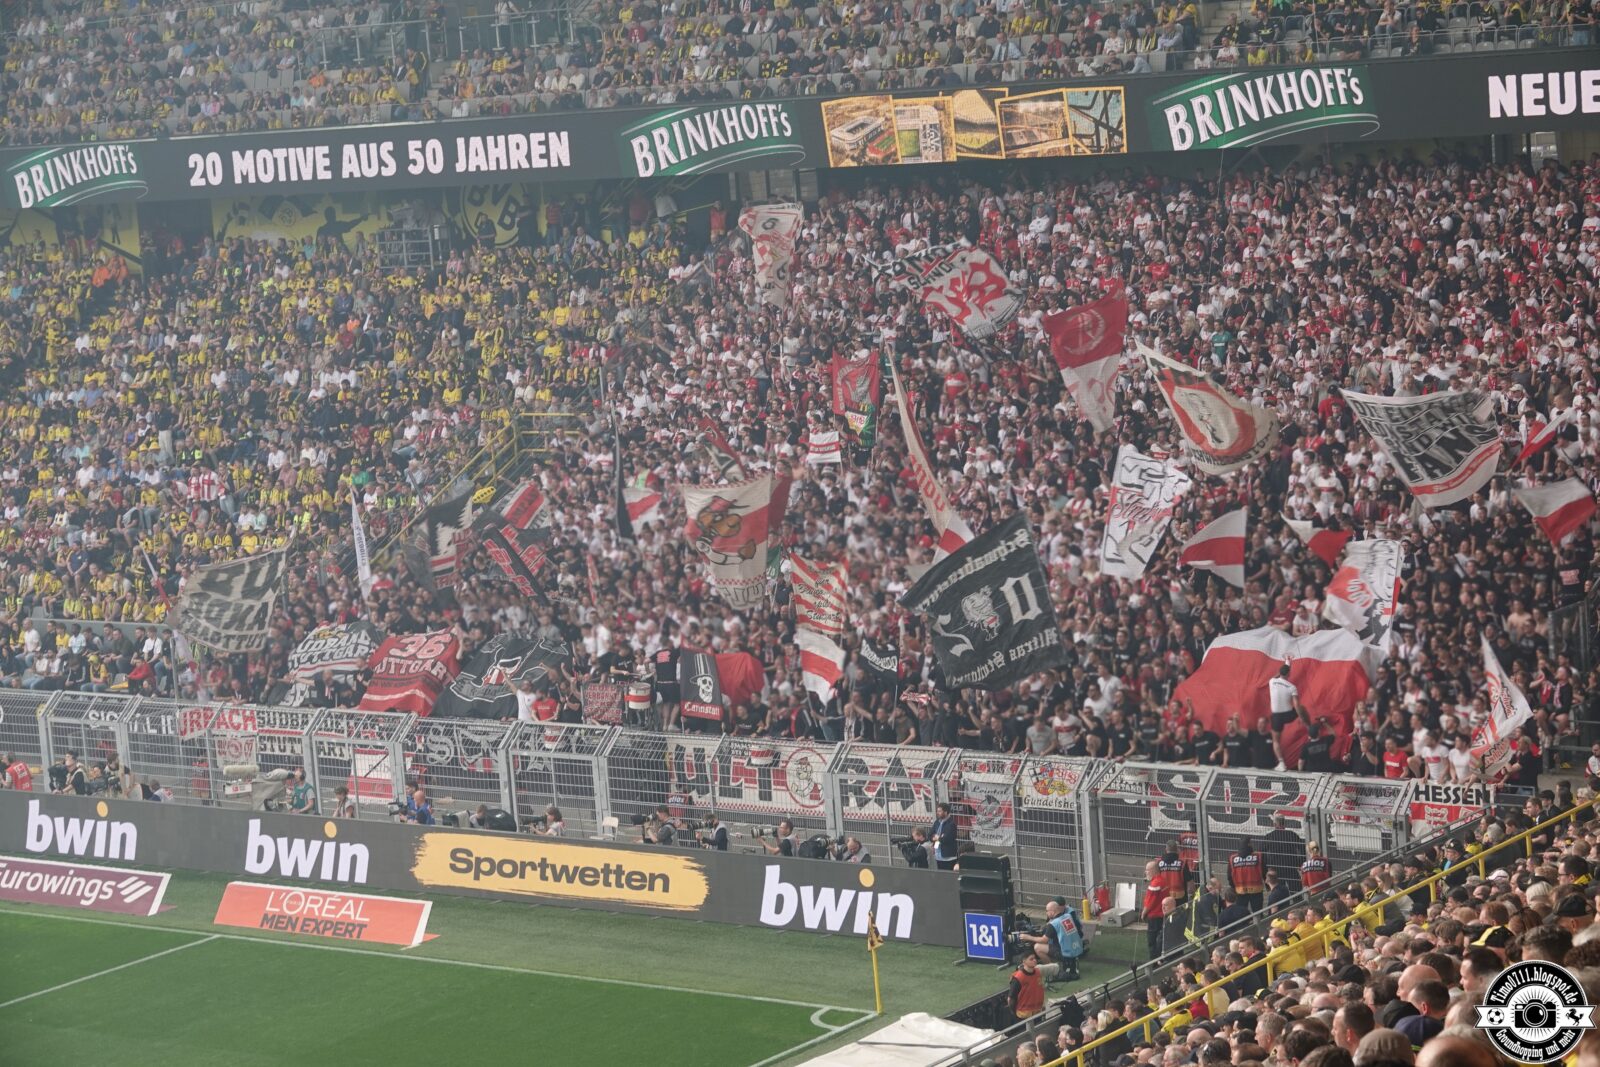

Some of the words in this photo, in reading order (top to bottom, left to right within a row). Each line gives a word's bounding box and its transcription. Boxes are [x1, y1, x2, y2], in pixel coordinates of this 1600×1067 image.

[1163, 67, 1364, 152] BRINKHOFF's
[1488, 70, 1600, 119] NEUE
[188, 153, 223, 188] 20
[232, 144, 333, 184] MOTIVE
[341, 141, 398, 179] AUS
[407, 139, 444, 176] 50
[455, 131, 571, 173] JAHREN
[630, 103, 793, 178] BRINKHOFF's
[13, 144, 138, 209] BRINKHOFF's
[389, 631, 452, 659] 36
[1414, 783, 1491, 805] HESSEN
[25, 799, 138, 861] bwin
[244, 819, 370, 884] bwin
[449, 848, 670, 893] Sportwetten
[260, 913, 300, 933] MEN
[300, 917, 368, 939] EXPERT
[759, 864, 915, 939] bwin
[969, 922, 1001, 948] 1&1
